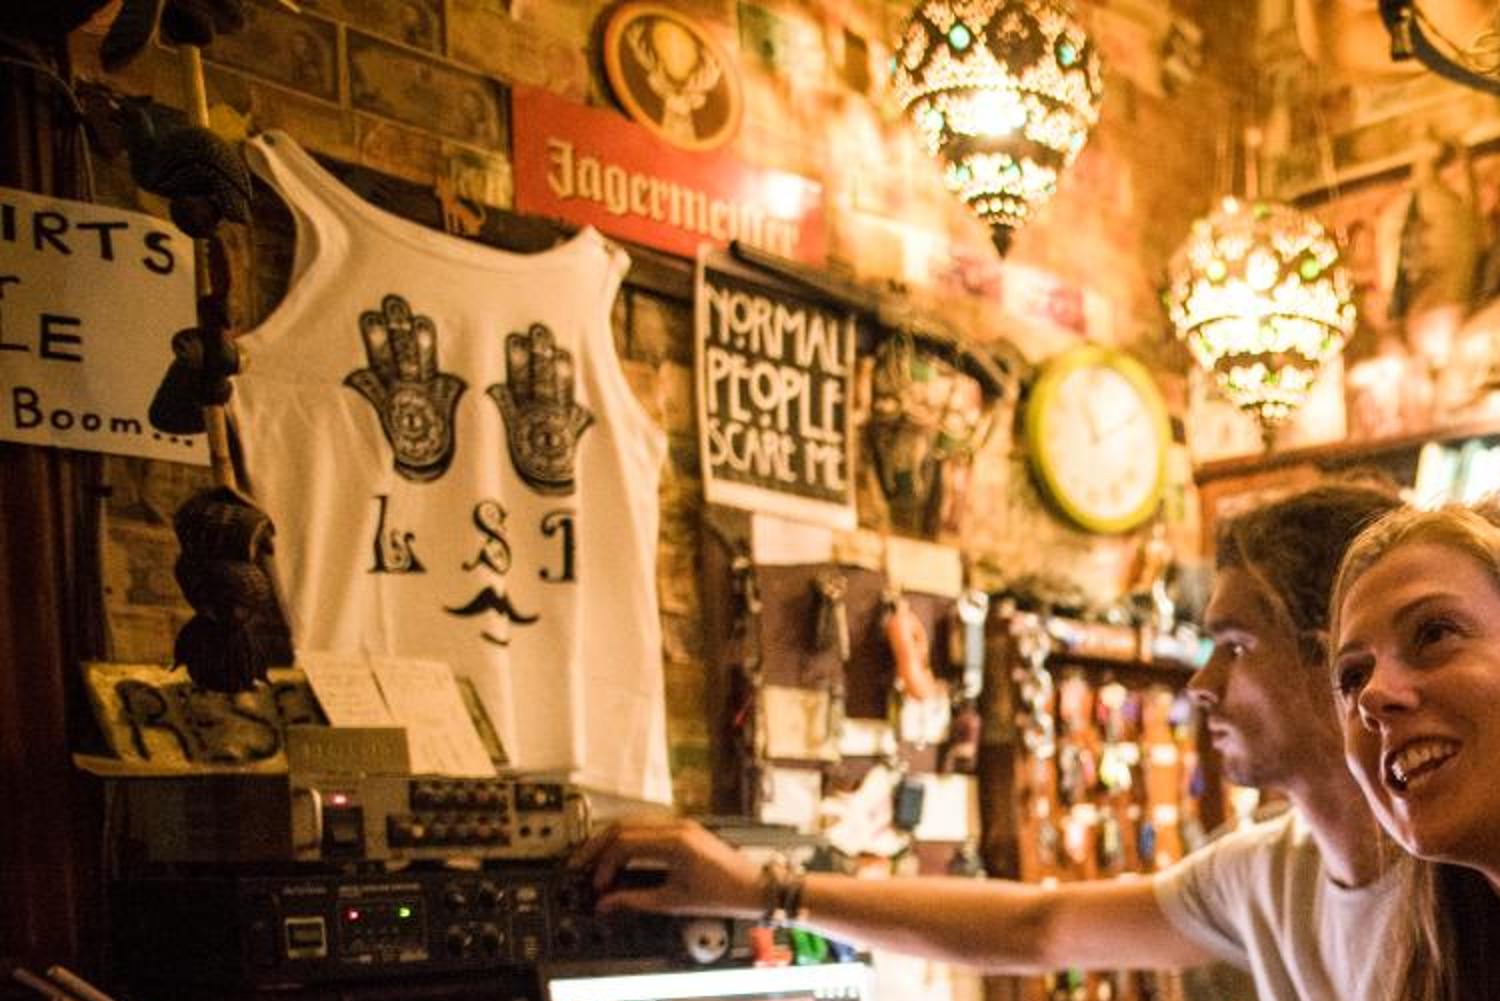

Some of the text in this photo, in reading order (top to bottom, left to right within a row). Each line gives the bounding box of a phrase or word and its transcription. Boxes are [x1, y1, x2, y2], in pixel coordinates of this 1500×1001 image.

[704, 283, 850, 377] NORMAL
[706, 346, 847, 444] PEOPLE
[707, 415, 849, 491] SCARE ME
